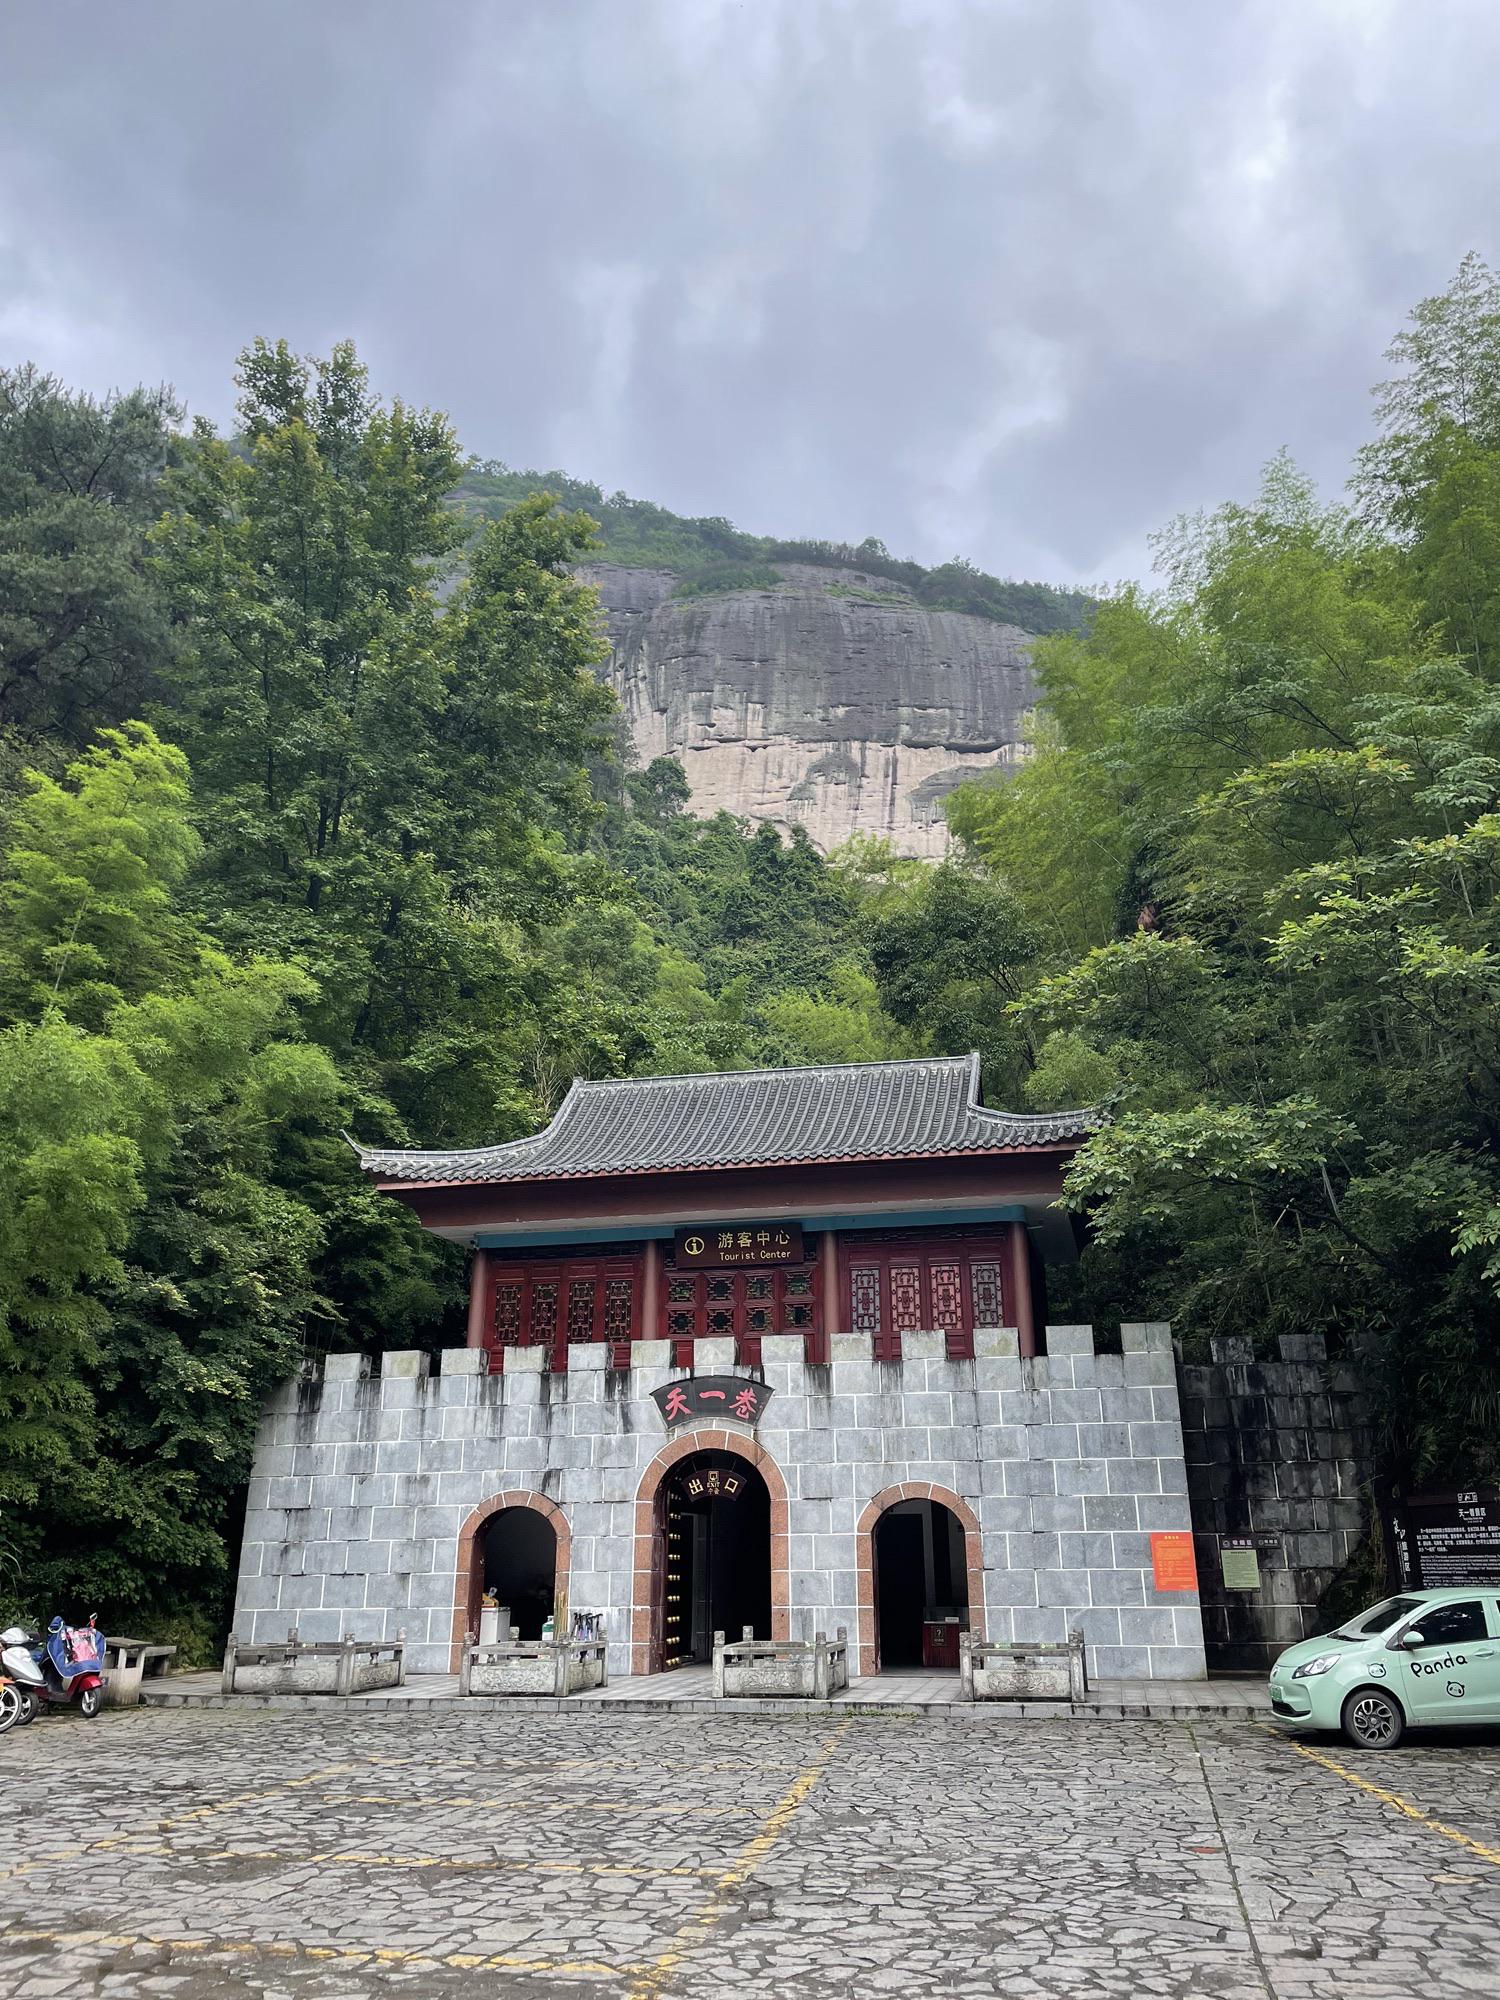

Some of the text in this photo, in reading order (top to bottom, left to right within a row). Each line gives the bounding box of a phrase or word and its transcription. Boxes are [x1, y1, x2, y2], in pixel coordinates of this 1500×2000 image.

[718, 1230, 790, 1249] 游客中心
[720, 1250, 791, 1261] Tourist Center
[665, 1387, 758, 1420] 天一巷
[1411, 1651, 1468, 1677] Panda
